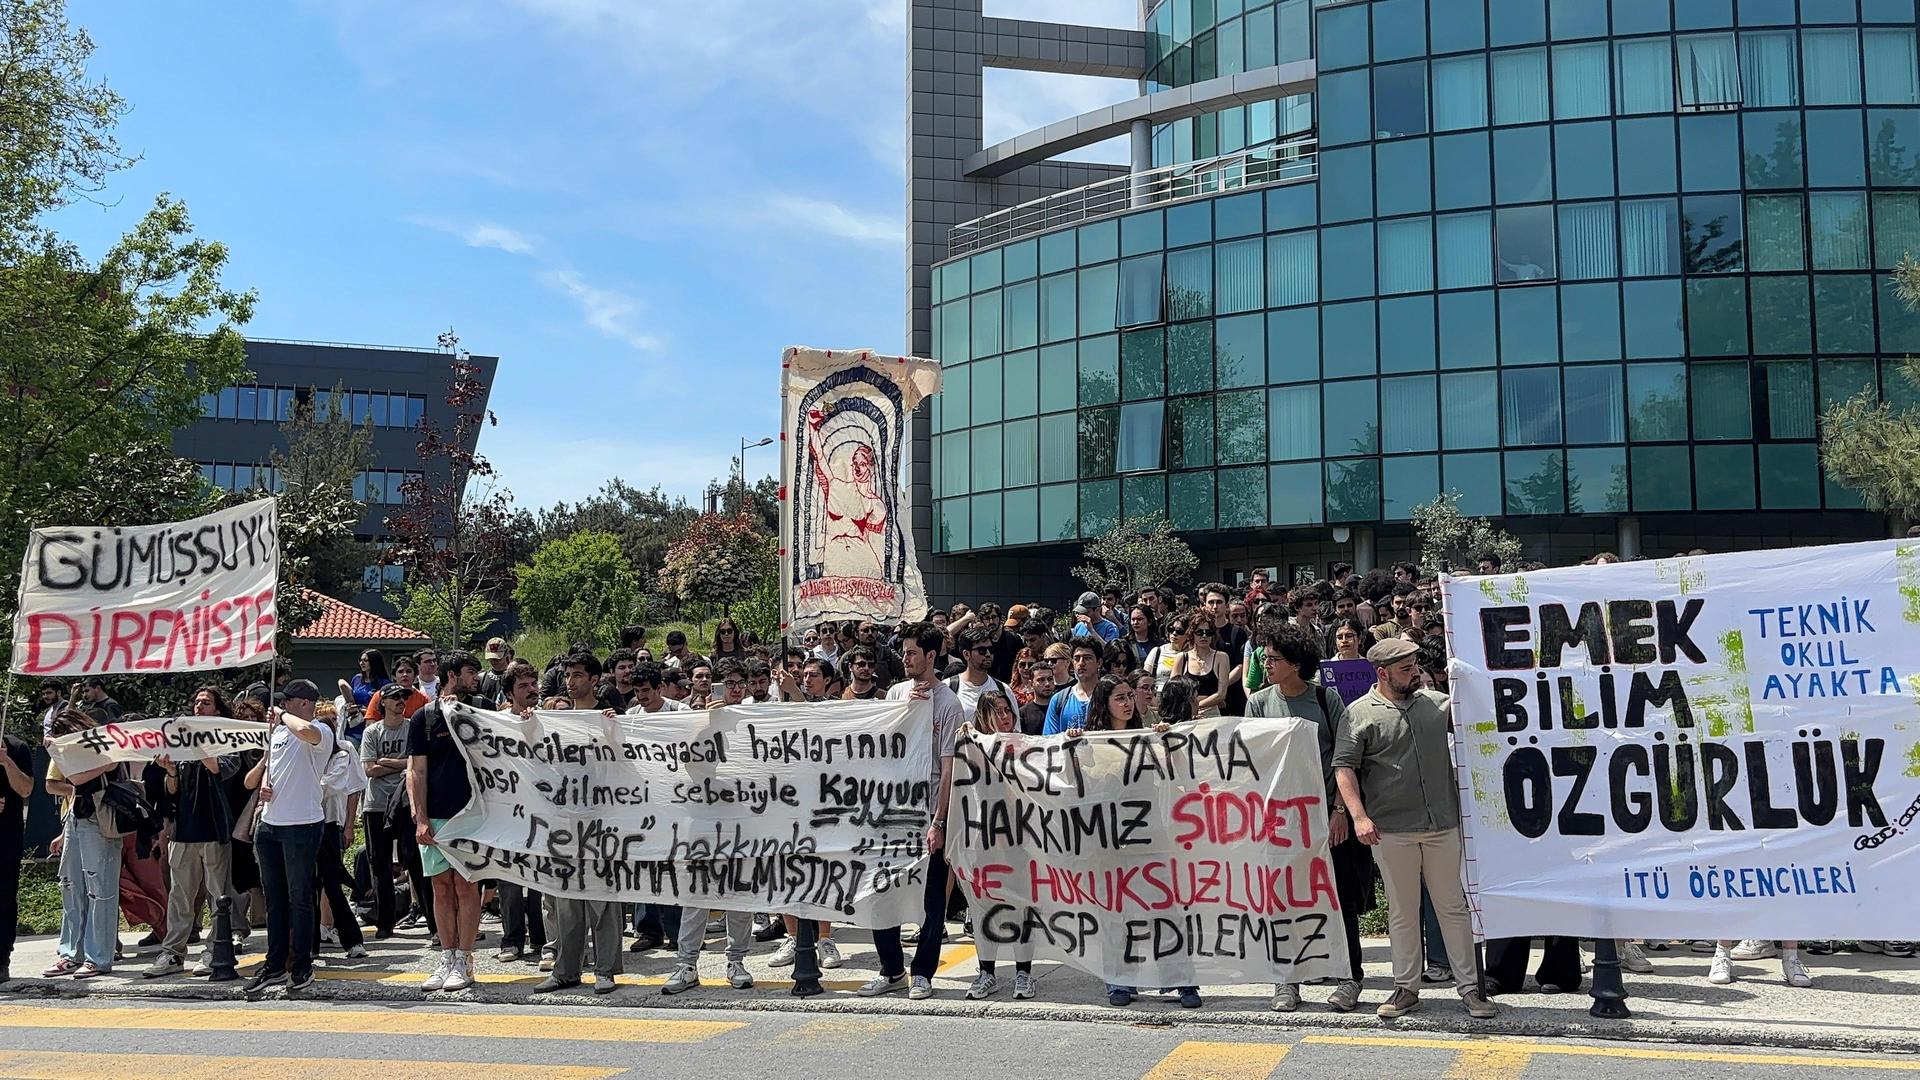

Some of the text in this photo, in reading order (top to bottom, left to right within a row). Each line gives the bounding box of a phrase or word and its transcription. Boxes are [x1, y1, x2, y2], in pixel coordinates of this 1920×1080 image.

[38, 511, 275, 591] GÜMÜŞSUYU
[21, 588, 275, 673] DİRENİŞTE
[1478, 598, 1708, 671] EMEK
[1748, 595, 1876, 639] TEKNİK
[1762, 666, 1901, 700] AYAKTA
[1780, 640, 1860, 668] OKUL
[1492, 666, 1695, 733] BİLİM
[381, 739, 405, 755] CAT
[450, 702, 907, 772] Öğrencilerin anayasal haklarının
[953, 728, 1260, 798] SİYASET YAPMA
[535, 774, 649, 807] edilmesi
[671, 773, 800, 814] sebebiyle
[819, 773, 930, 828] Kayyum
[1502, 728, 1890, 839] ÖZGÜRLÜK
[667, 820, 818, 862] hakkında
[961, 782, 1321, 856] HAKKIMIZ ŞİDDET
[872, 861, 923, 894] ÖTK
[957, 857, 1340, 916] VE HUKUKSUZLUKLA
[1623, 860, 1857, 899] İTÜ ÖĞRENCİLERİ
[981, 902, 1330, 965] GASP EDİLEMEZ
